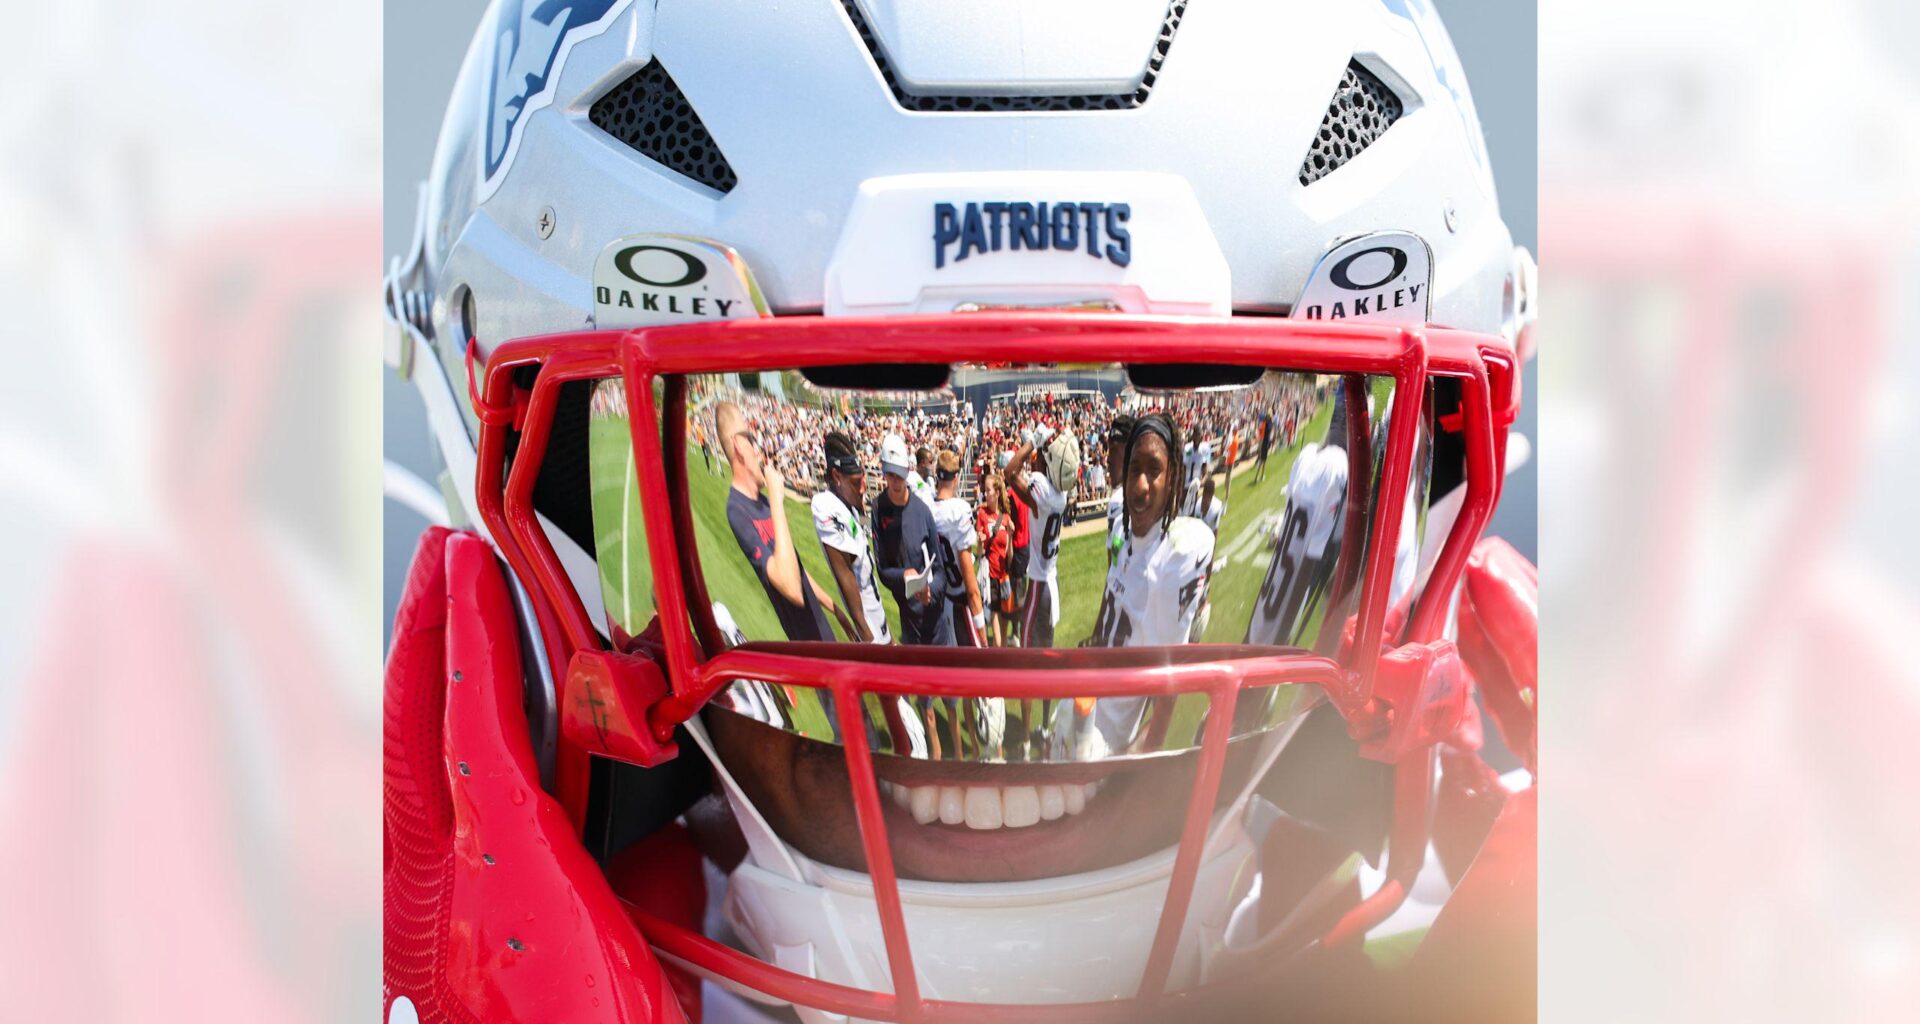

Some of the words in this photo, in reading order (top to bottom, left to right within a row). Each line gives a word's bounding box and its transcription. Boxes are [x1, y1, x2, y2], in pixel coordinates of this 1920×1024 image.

[933, 201, 1131, 270] PATRIOTS
[596, 286, 733, 317] OAKLEY
[1306, 284, 1421, 320] OAKLEY
